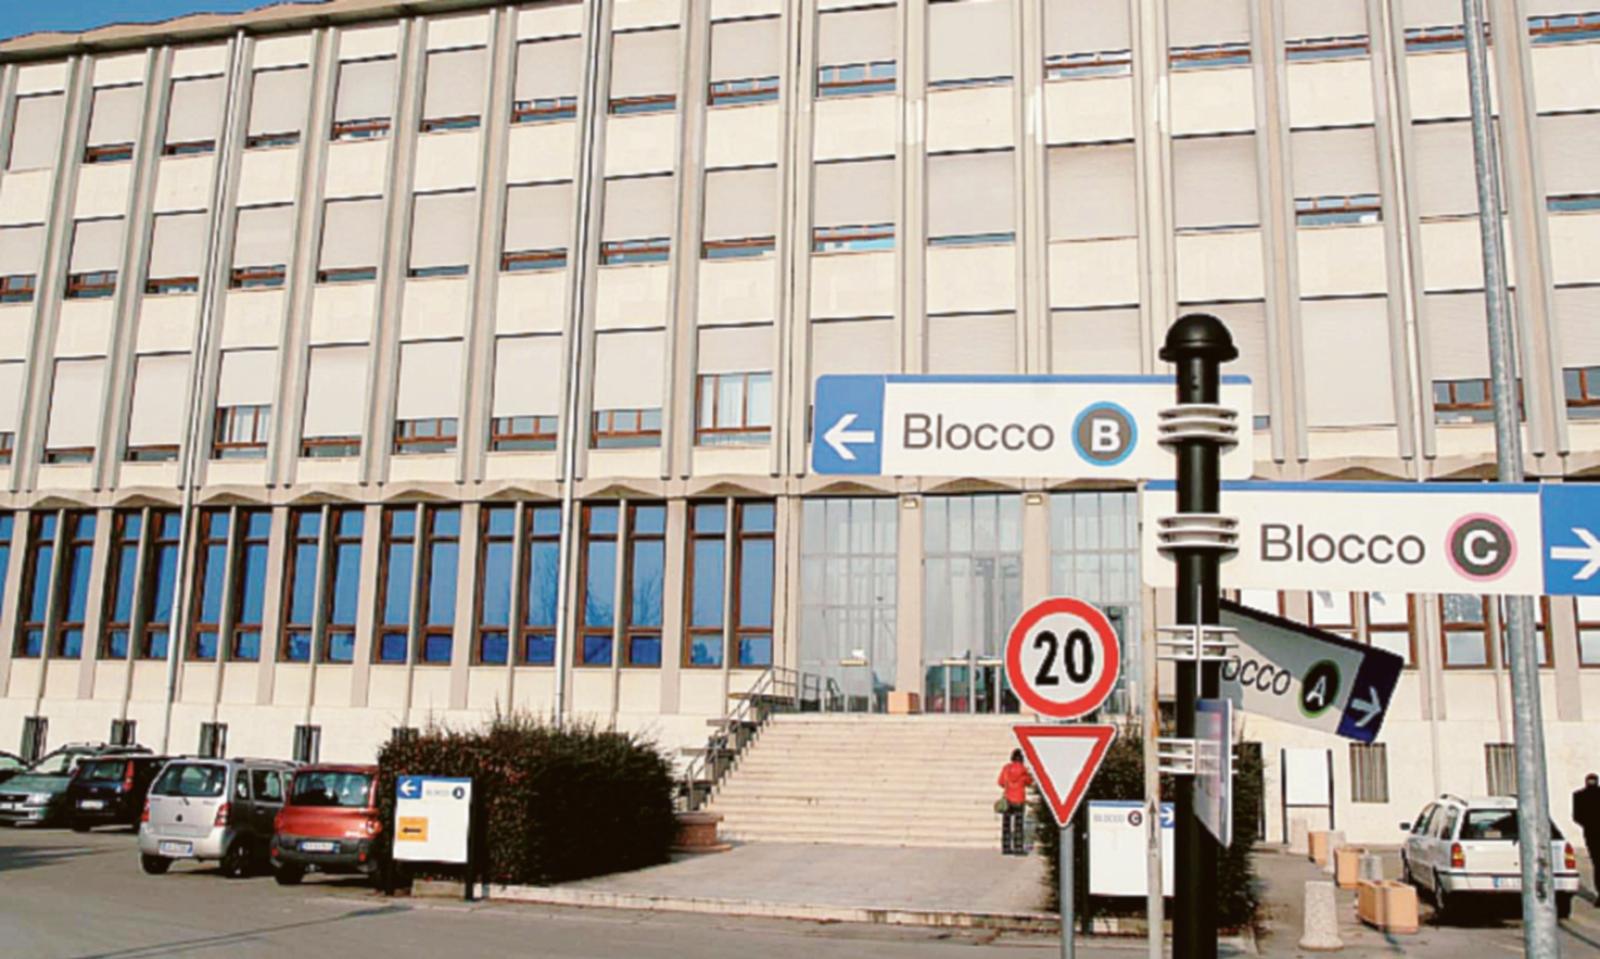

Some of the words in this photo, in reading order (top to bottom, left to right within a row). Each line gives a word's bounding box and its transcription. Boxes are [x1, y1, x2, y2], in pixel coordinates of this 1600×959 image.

[903, 413, 1055, 451] Blocco
[1090, 417, 1121, 453] B
[1260, 523, 1426, 565] Blocco
[1462, 529, 1499, 566] C
[1033, 628, 1094, 686] 20
[1221, 655, 1291, 696] occo
[1306, 674, 1327, 707] A
